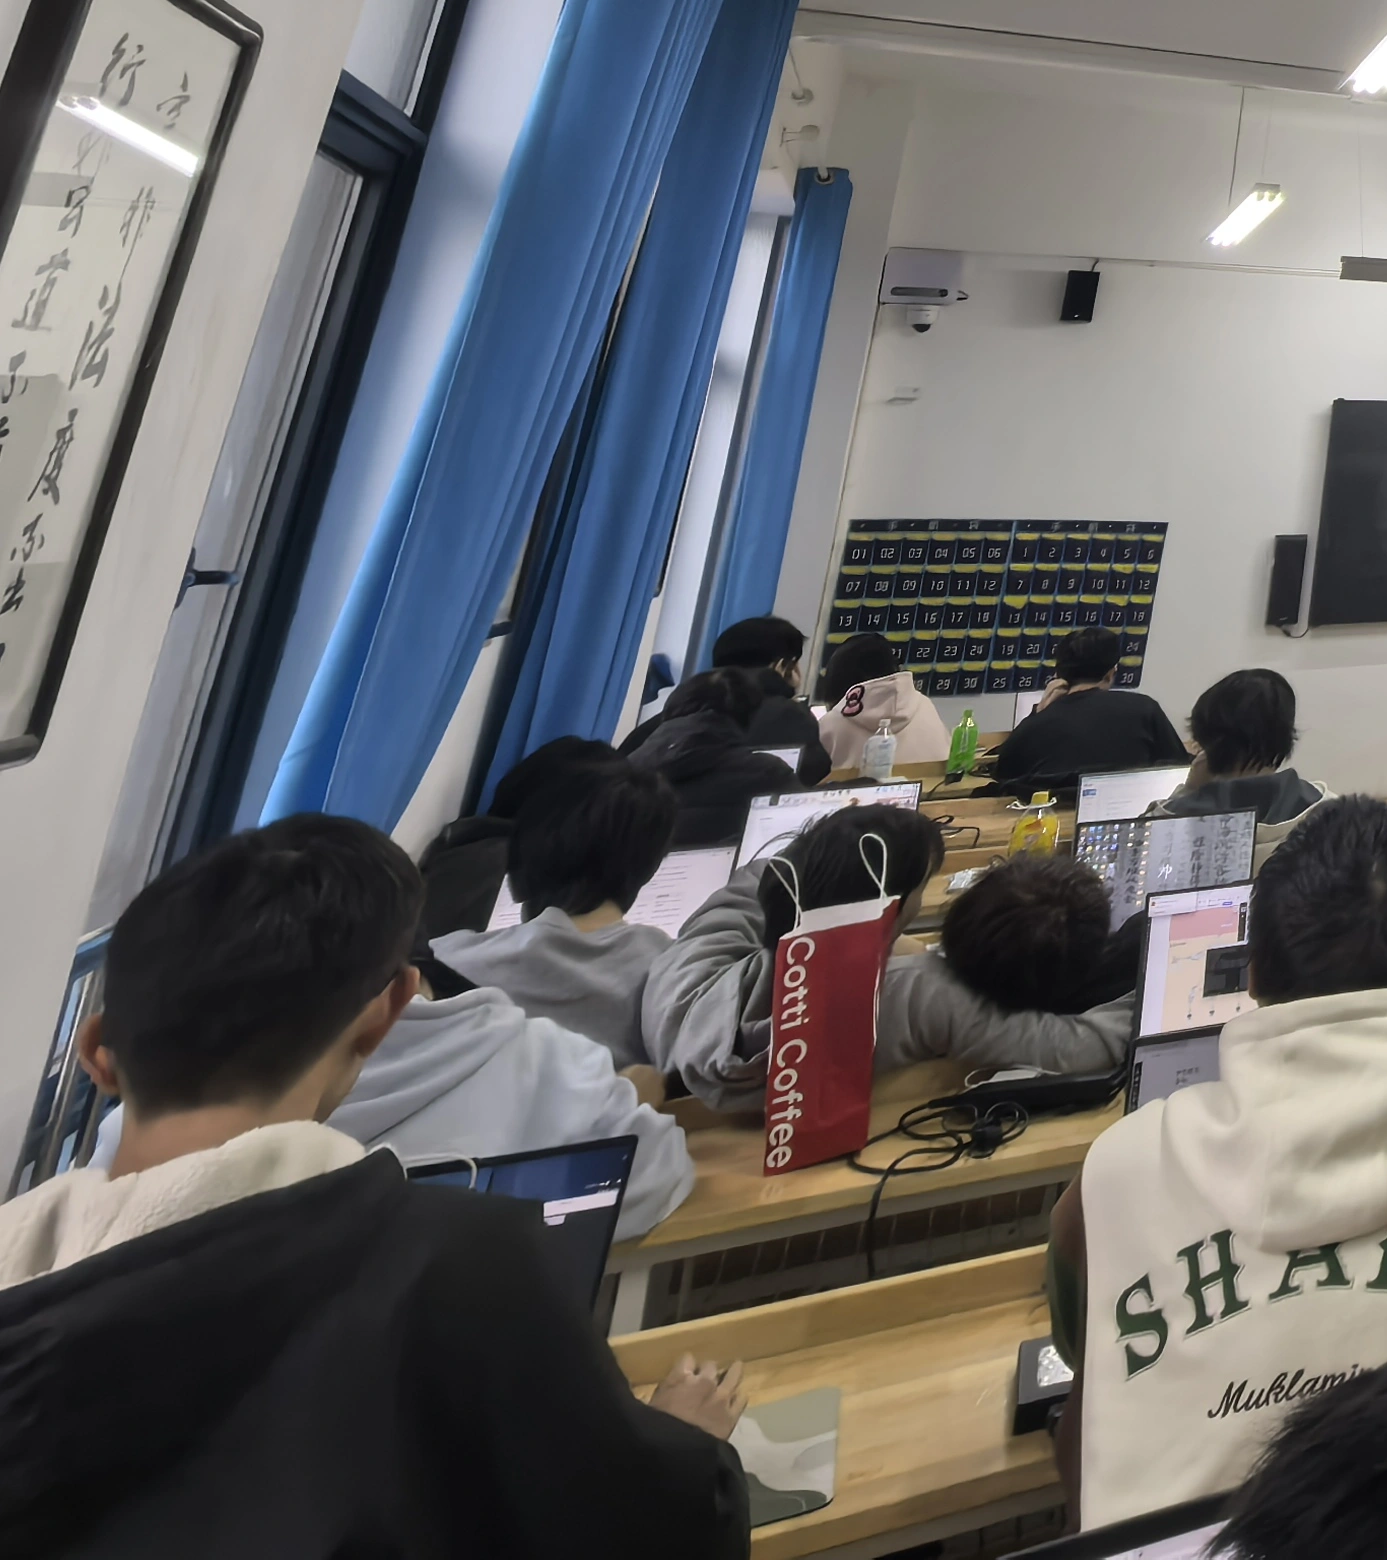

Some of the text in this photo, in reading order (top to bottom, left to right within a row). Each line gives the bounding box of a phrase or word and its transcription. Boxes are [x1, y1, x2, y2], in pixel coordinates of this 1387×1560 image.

[852, 547, 1001, 560] 01 02 03 04 05 06
[1023, 547, 1154, 560] 1 2 3 4 5 6
[846, 580, 996, 592] 07 08 09 10 11 12
[1017, 578, 1150, 590] 7 8 9 10 11 12
[839, 611, 990, 627] 13 14 15 16 17 18
[1008, 611, 1145, 624] 13 14 15 16 17 18
[916, 647, 930, 658] 22
[944, 645, 958, 656] 23
[970, 645, 983, 656] 24
[1002, 645, 1014, 655] 19
[1026, 644, 1040, 655] 20
[1126, 642, 1139, 652] 24
[937, 679, 950, 690] 29
[964, 678, 977, 689] 30
[993, 677, 1006, 689] 25
[1019, 676, 1032, 687] 26
[1120, 672, 1133, 683] 30
[766, 936, 815, 1169] Cotti Coffee
[1207, 1363, 1368, 1419] Muklami
